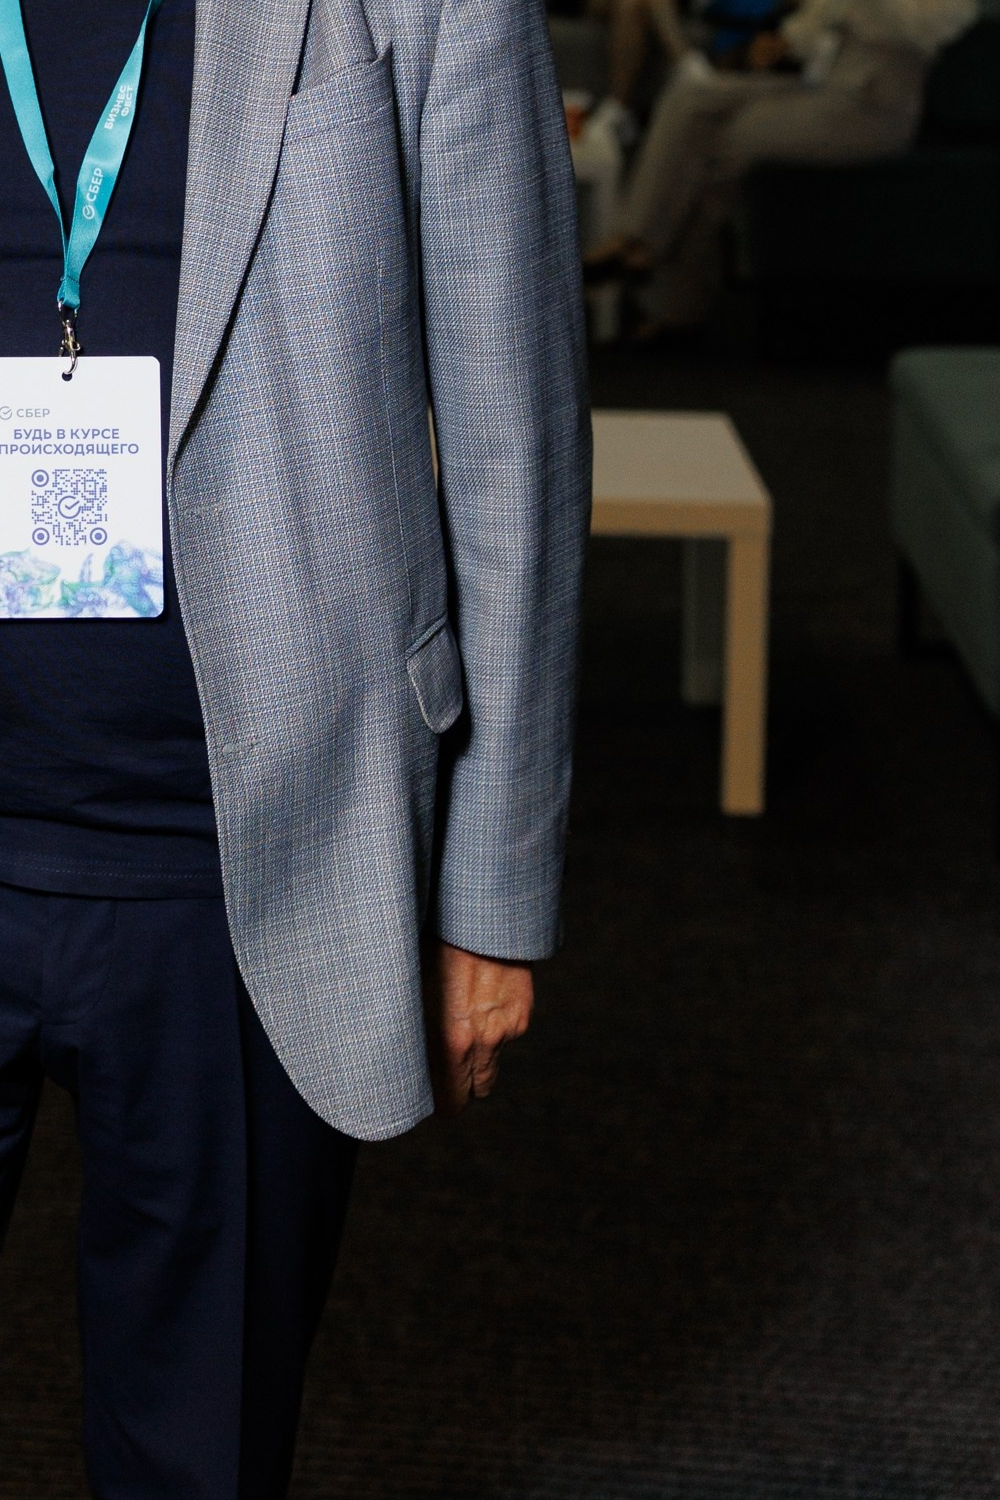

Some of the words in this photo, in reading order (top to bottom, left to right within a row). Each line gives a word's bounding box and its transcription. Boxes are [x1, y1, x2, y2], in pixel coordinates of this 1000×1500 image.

[104, 85, 128, 130] БИЗНЕС
[121, 86, 134, 117] ФЕСТ
[86, 168, 104, 202] СБЕР
[17, 409, 50, 418] СБЕР
[13, 429, 52, 441] БУДЬ
[56, 429, 66, 439] В
[70, 429, 120, 439] КУРСЕ
